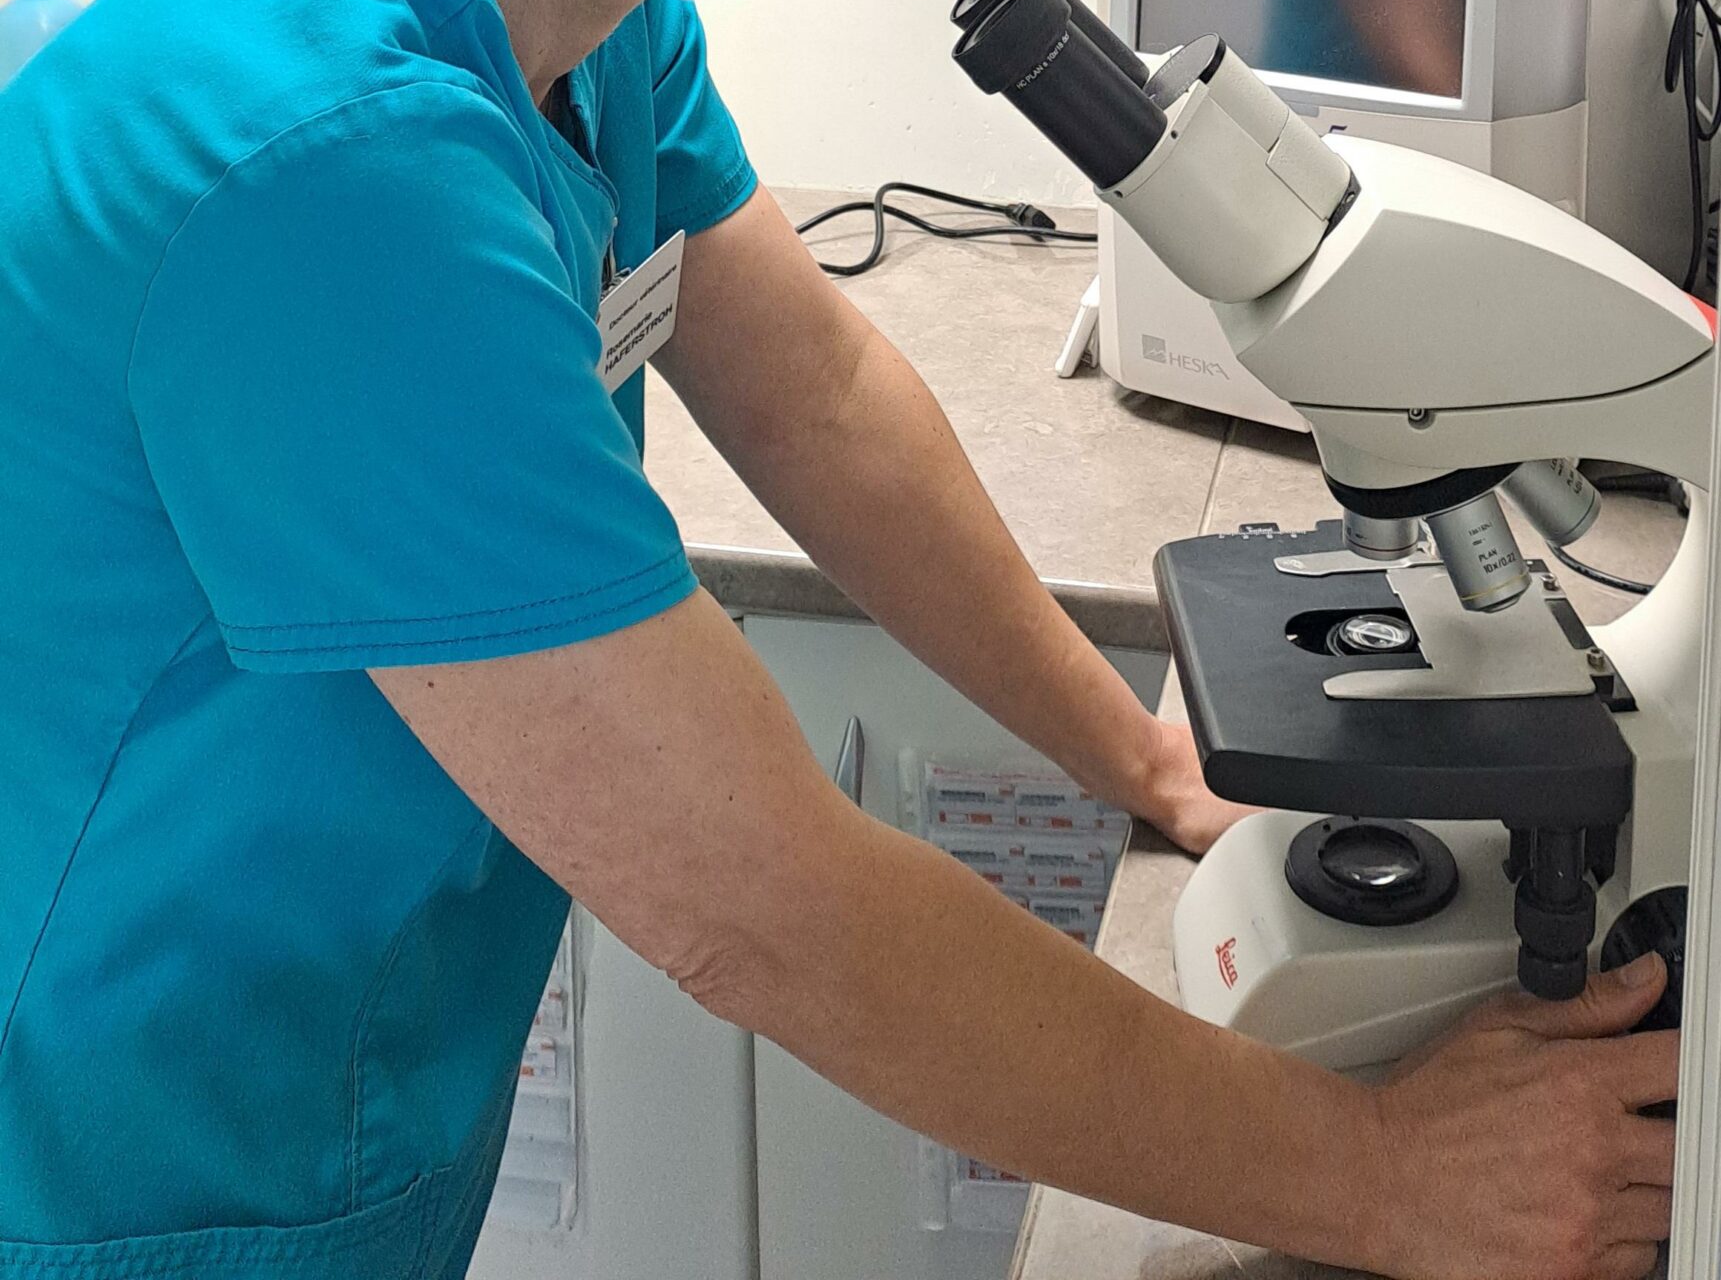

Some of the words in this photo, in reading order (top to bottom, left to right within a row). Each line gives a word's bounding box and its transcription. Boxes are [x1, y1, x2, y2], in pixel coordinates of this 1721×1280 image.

[1025, 64, 1044, 83] PLAN
[604, 303, 673, 375] HAFERSTROH
[606, 311, 653, 360] Rosemarie
[1169, 352, 1230, 380] HESKA
[1215, 937, 1239, 991] Leica
